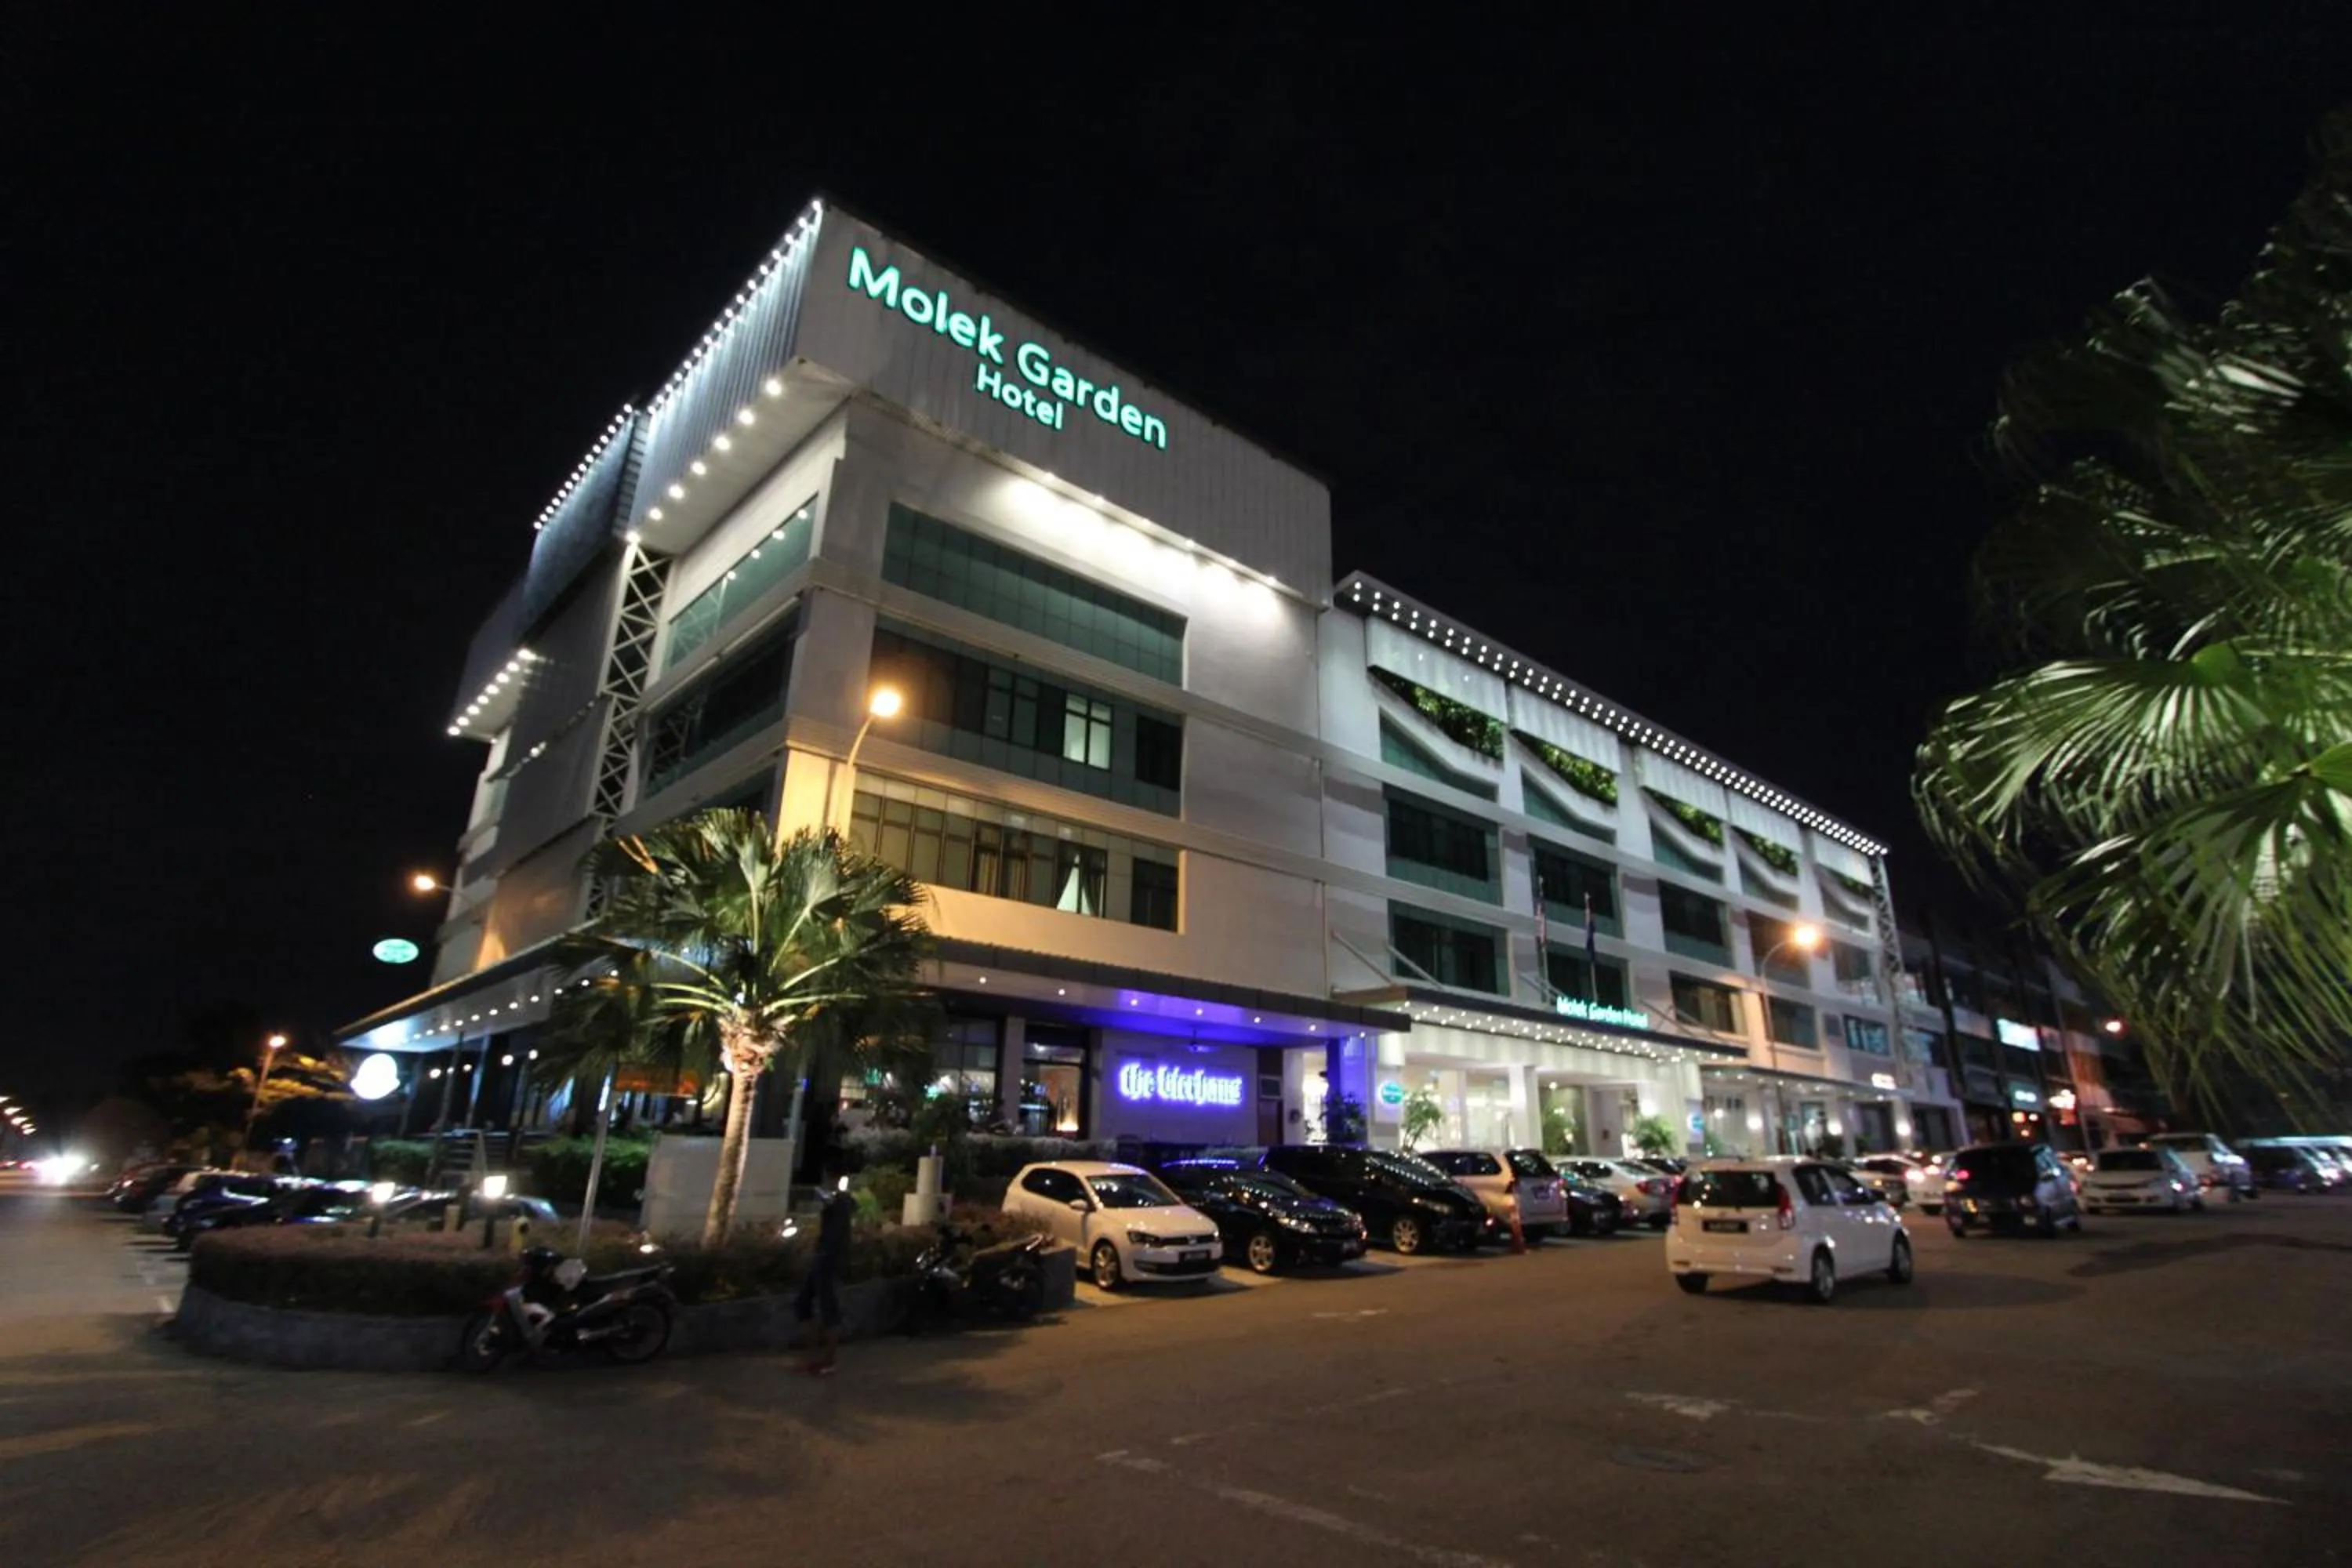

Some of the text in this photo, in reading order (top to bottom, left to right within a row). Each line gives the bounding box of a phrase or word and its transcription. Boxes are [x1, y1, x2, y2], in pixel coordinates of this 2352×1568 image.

[848, 246, 1167, 449] Molek Garden
[976, 363, 1063, 430] Hotel
